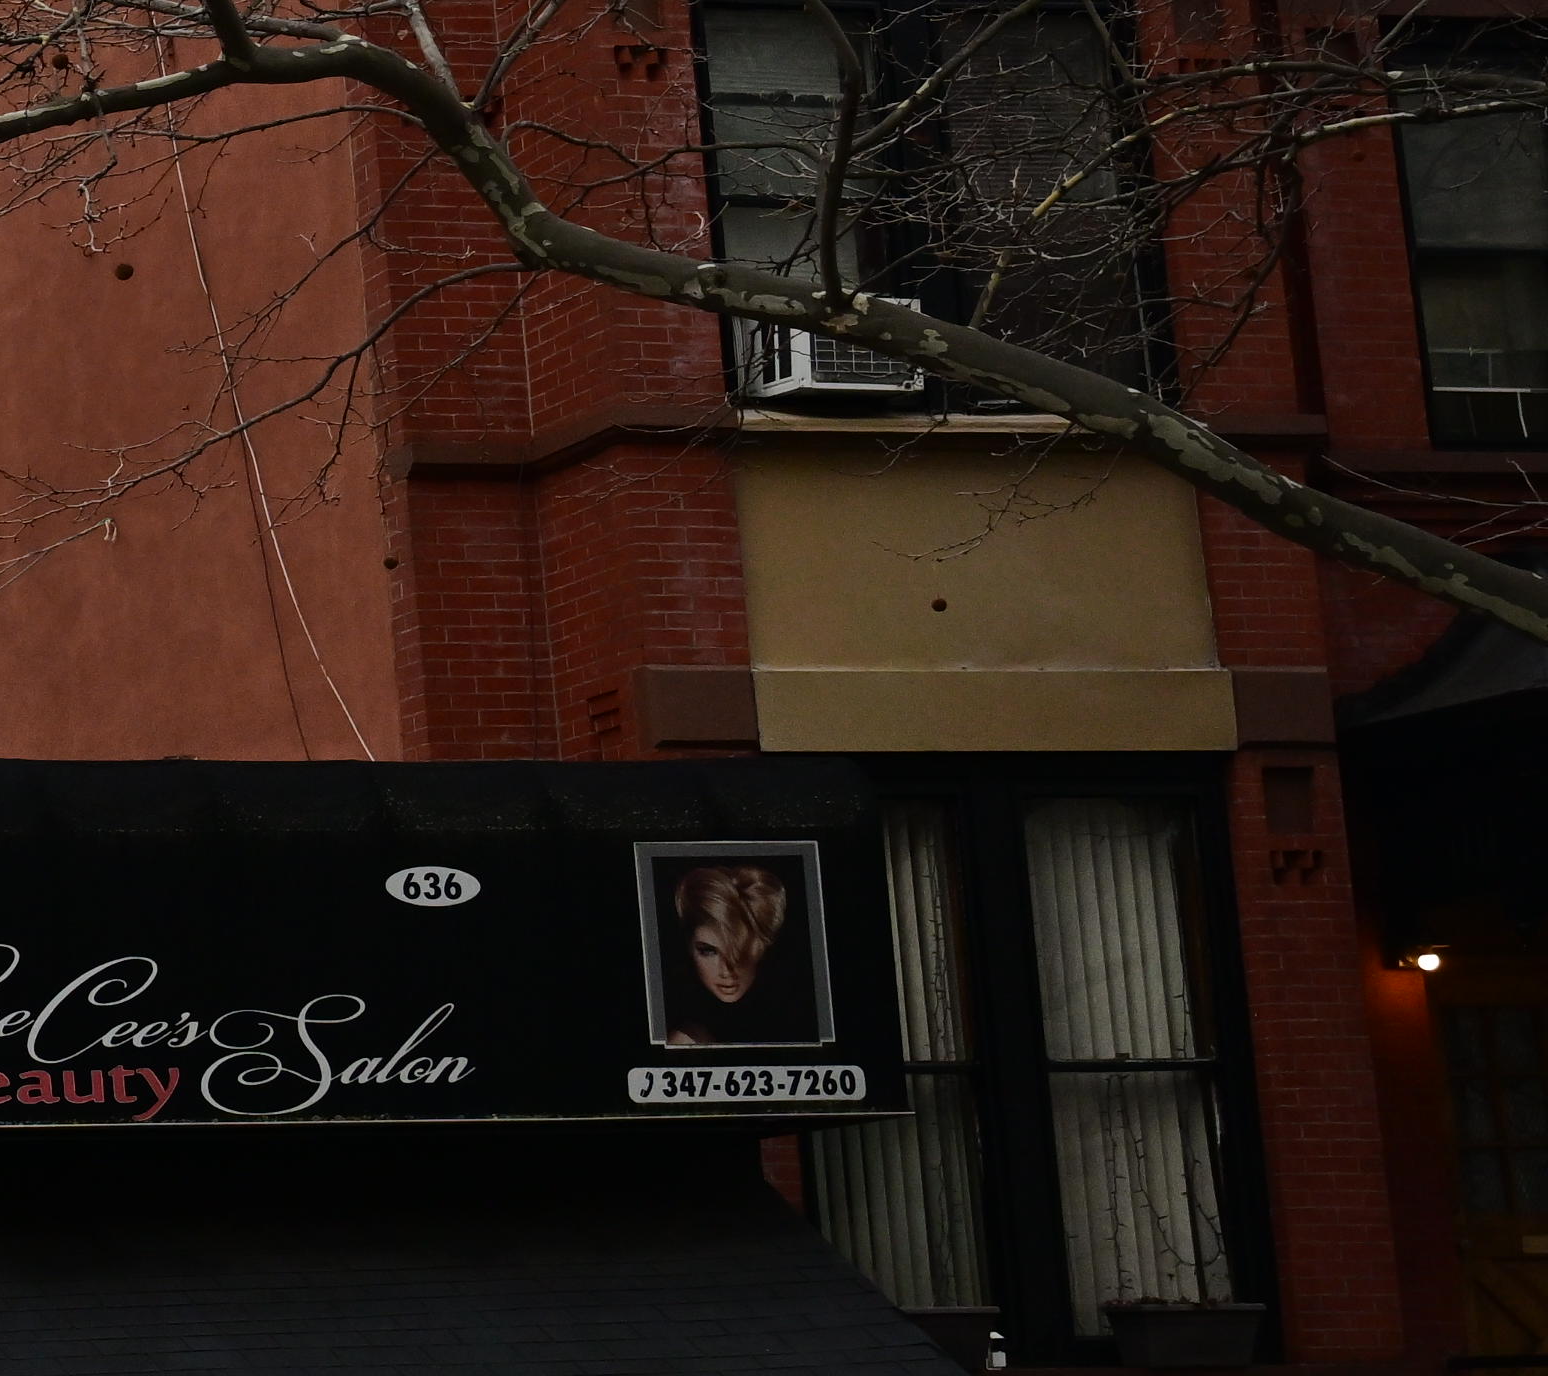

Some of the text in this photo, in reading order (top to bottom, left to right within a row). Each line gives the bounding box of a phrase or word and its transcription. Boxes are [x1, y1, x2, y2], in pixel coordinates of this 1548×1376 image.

[402, 872, 463, 901] 636
[199, 993, 477, 1115] Salon
[660, 1069, 857, 1099] 347-623-7260
